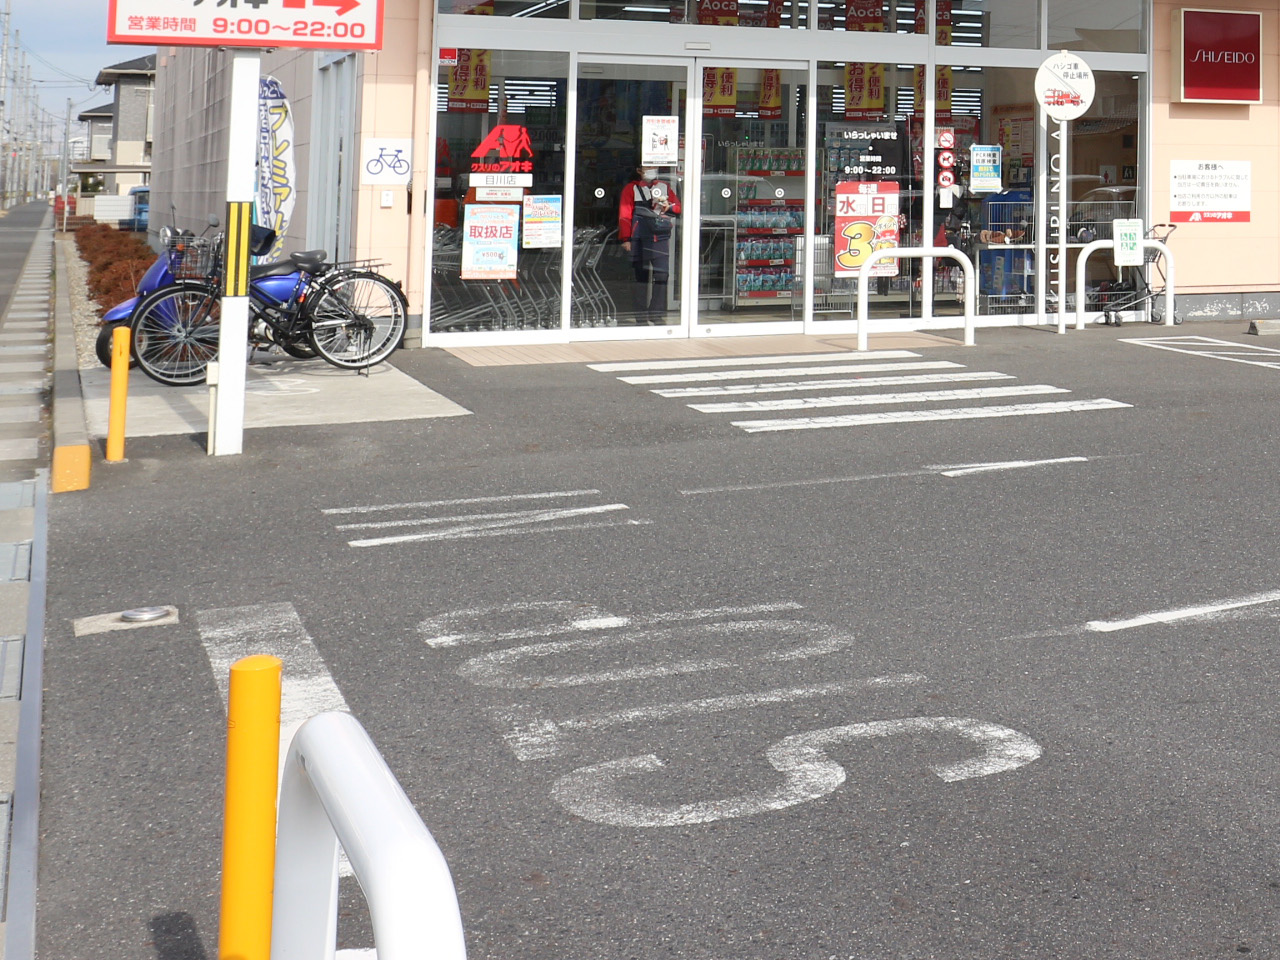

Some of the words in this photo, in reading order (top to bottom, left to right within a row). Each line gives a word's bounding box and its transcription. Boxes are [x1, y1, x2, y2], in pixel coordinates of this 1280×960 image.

[847, 6, 882, 18] Aoca
[127, 15, 197, 33] 営業時間
[1189, 48, 1256, 64] SHISEIDO
[1053, 62, 1080, 70] ハシゴ車
[1063, 71, 1090, 80] 停止場所
[844, 131, 898, 140] いらっしゃいませ
[470, 160, 533, 173] クスリのアオキ
[1198, 163, 1225, 171] お客様へ
[485, 175, 517, 186] 目川店
[468, 225, 514, 239] 取扱店
